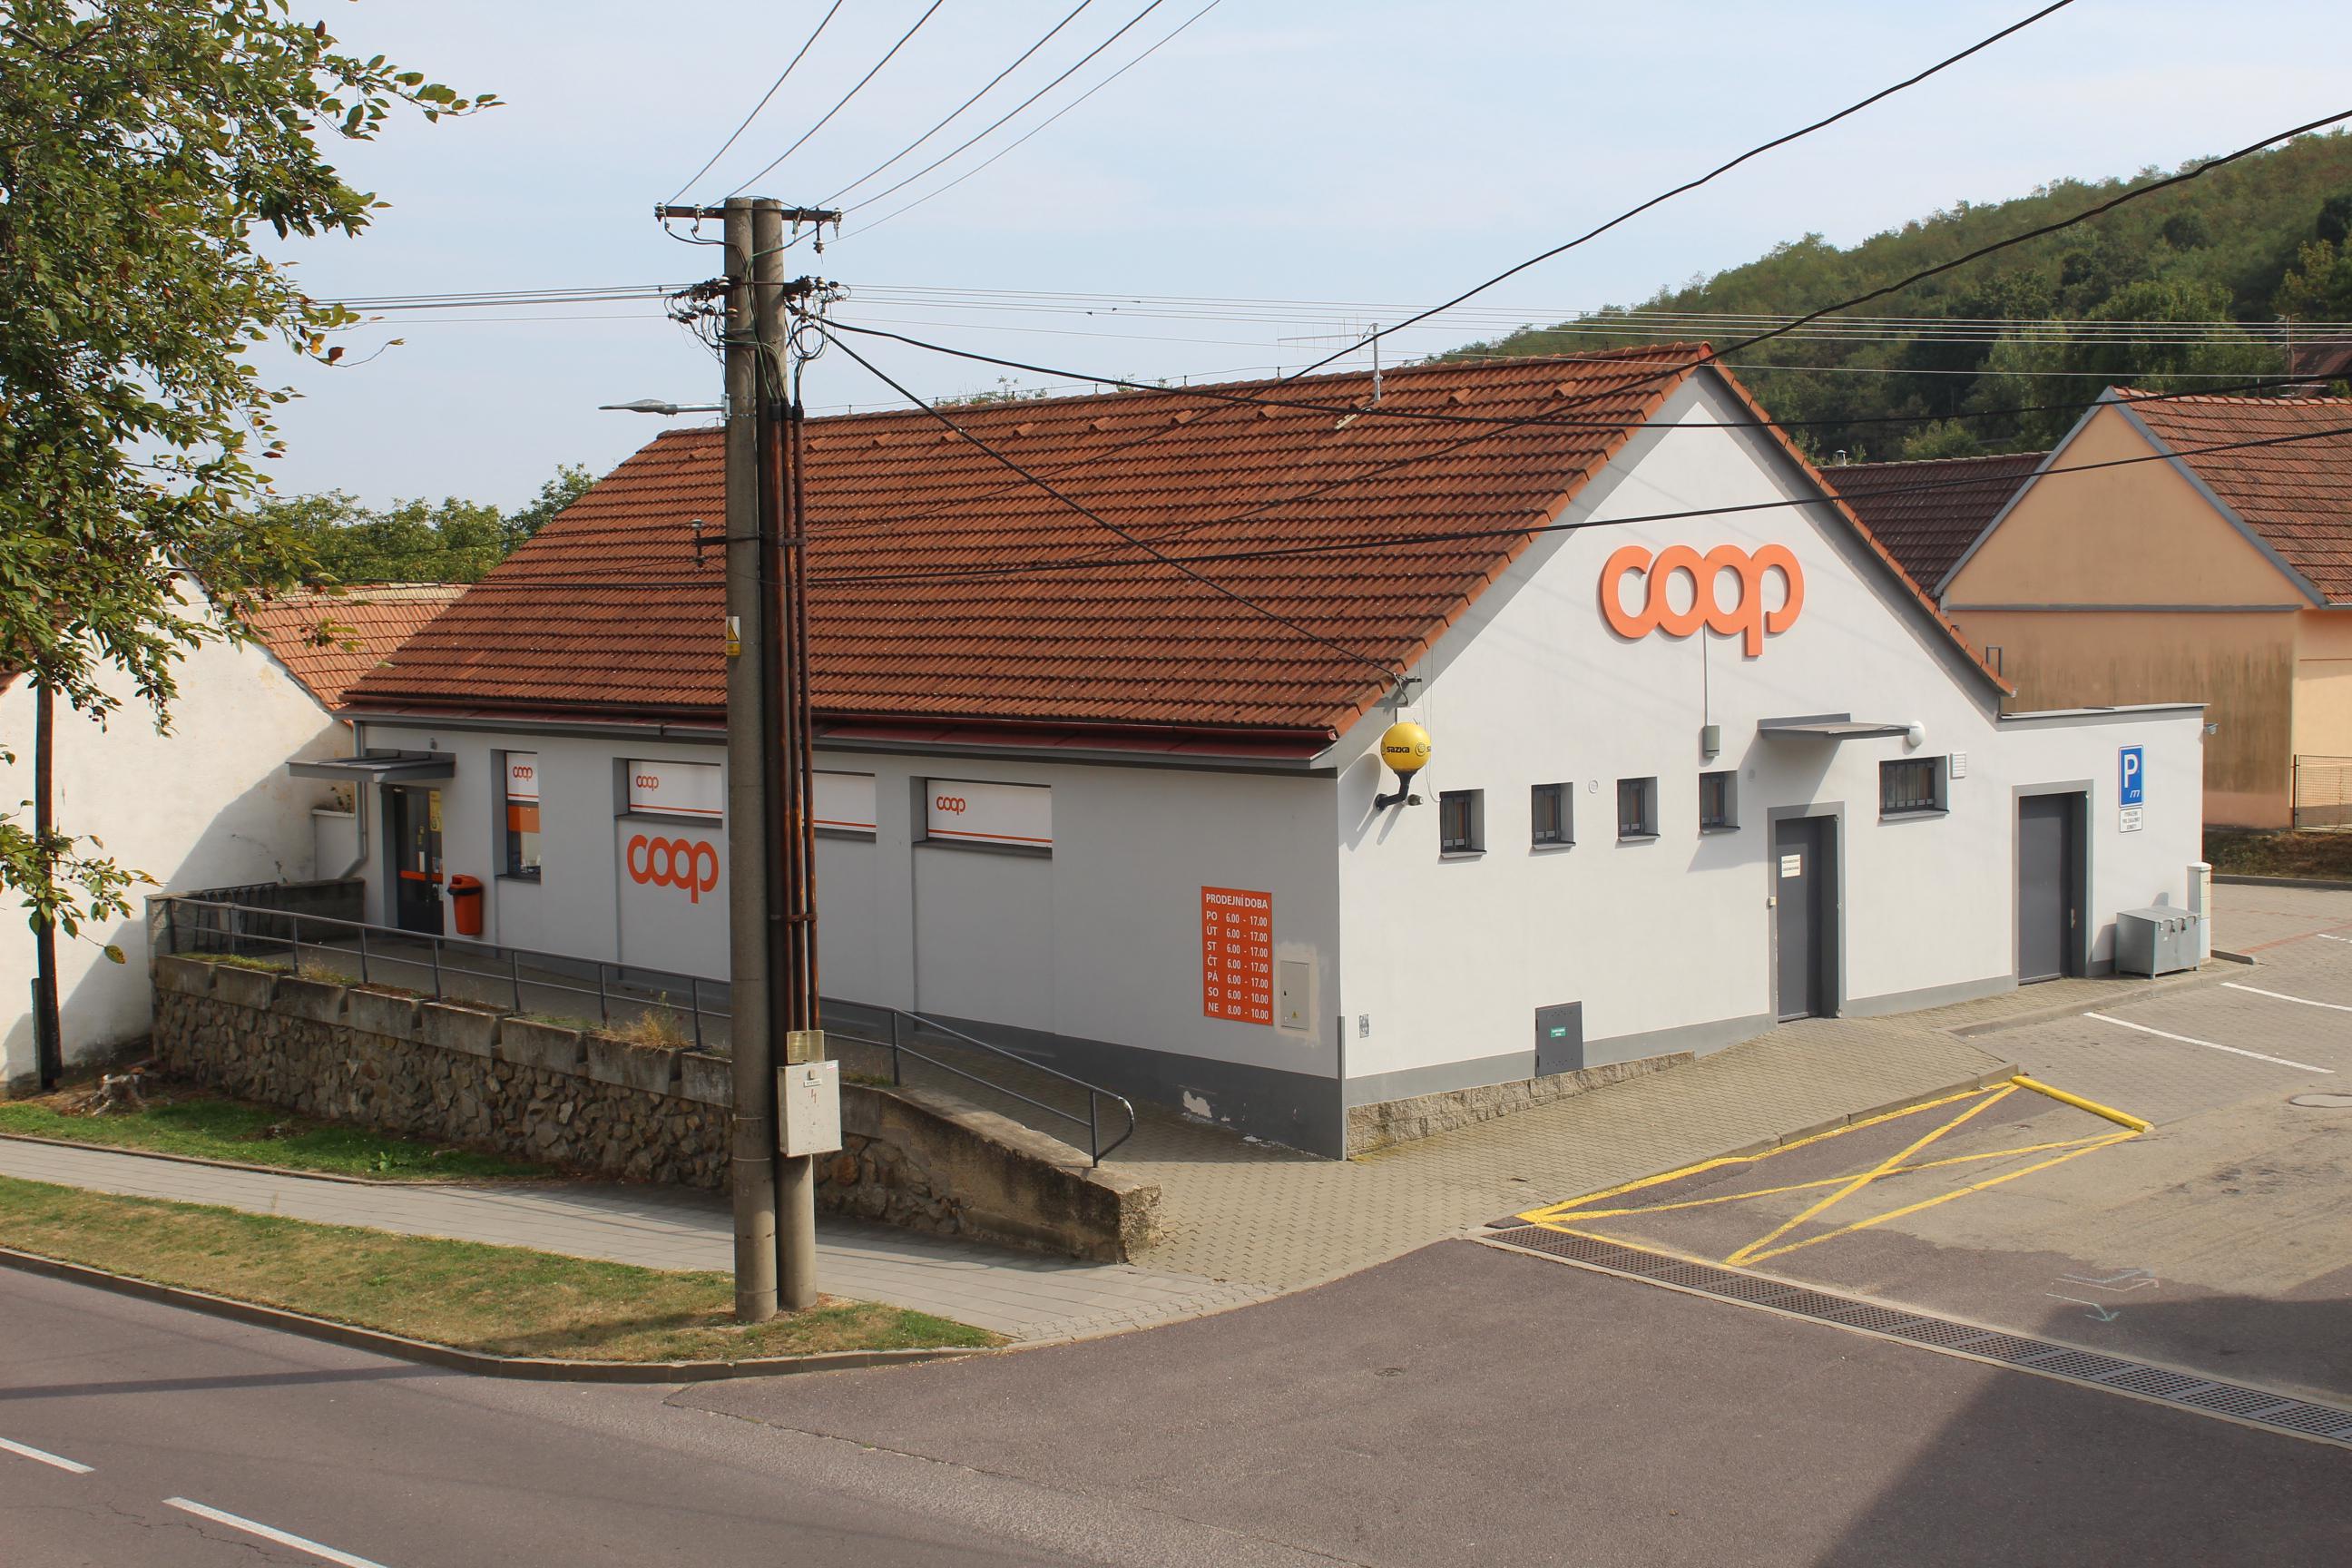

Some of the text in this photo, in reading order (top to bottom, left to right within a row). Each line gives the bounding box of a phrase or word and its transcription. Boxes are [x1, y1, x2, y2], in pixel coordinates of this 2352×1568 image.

[1600, 544, 1805, 657] coop
[513, 766, 534, 781] coop
[2123, 753, 2139, 789] P
[636, 775, 660, 791] coop
[936, 796, 966, 816] coop
[627, 834, 720, 905] coop
[1206, 893, 1269, 909] PRODEJNÍ DOBA
[1206, 910, 1218, 921] PO
[1226, 912, 1240, 924] 6.00
[1250, 916, 1268, 927] 17.00
[1226, 927, 1240, 939] 6.00
[1250, 931, 1268, 943] 17.00
[1207, 941, 1217, 951] ST
[1227, 943, 1240, 954] 6.00
[1250, 946, 1268, 958] 17.00
[1227, 958, 1241, 970] 6.00
[1250, 962, 1269, 974] 17.00
[1227, 974, 1241, 985] 6.00
[1251, 977, 1269, 989] 17.00
[1208, 986, 1219, 997] SO
[1227, 989, 1241, 1001] 6.00
[1251, 993, 1269, 1004] 10.00
[1208, 1001, 1220, 1013] NE
[1227, 1004, 1241, 1015] 8.00
[1251, 1008, 1269, 1020] 10.00
